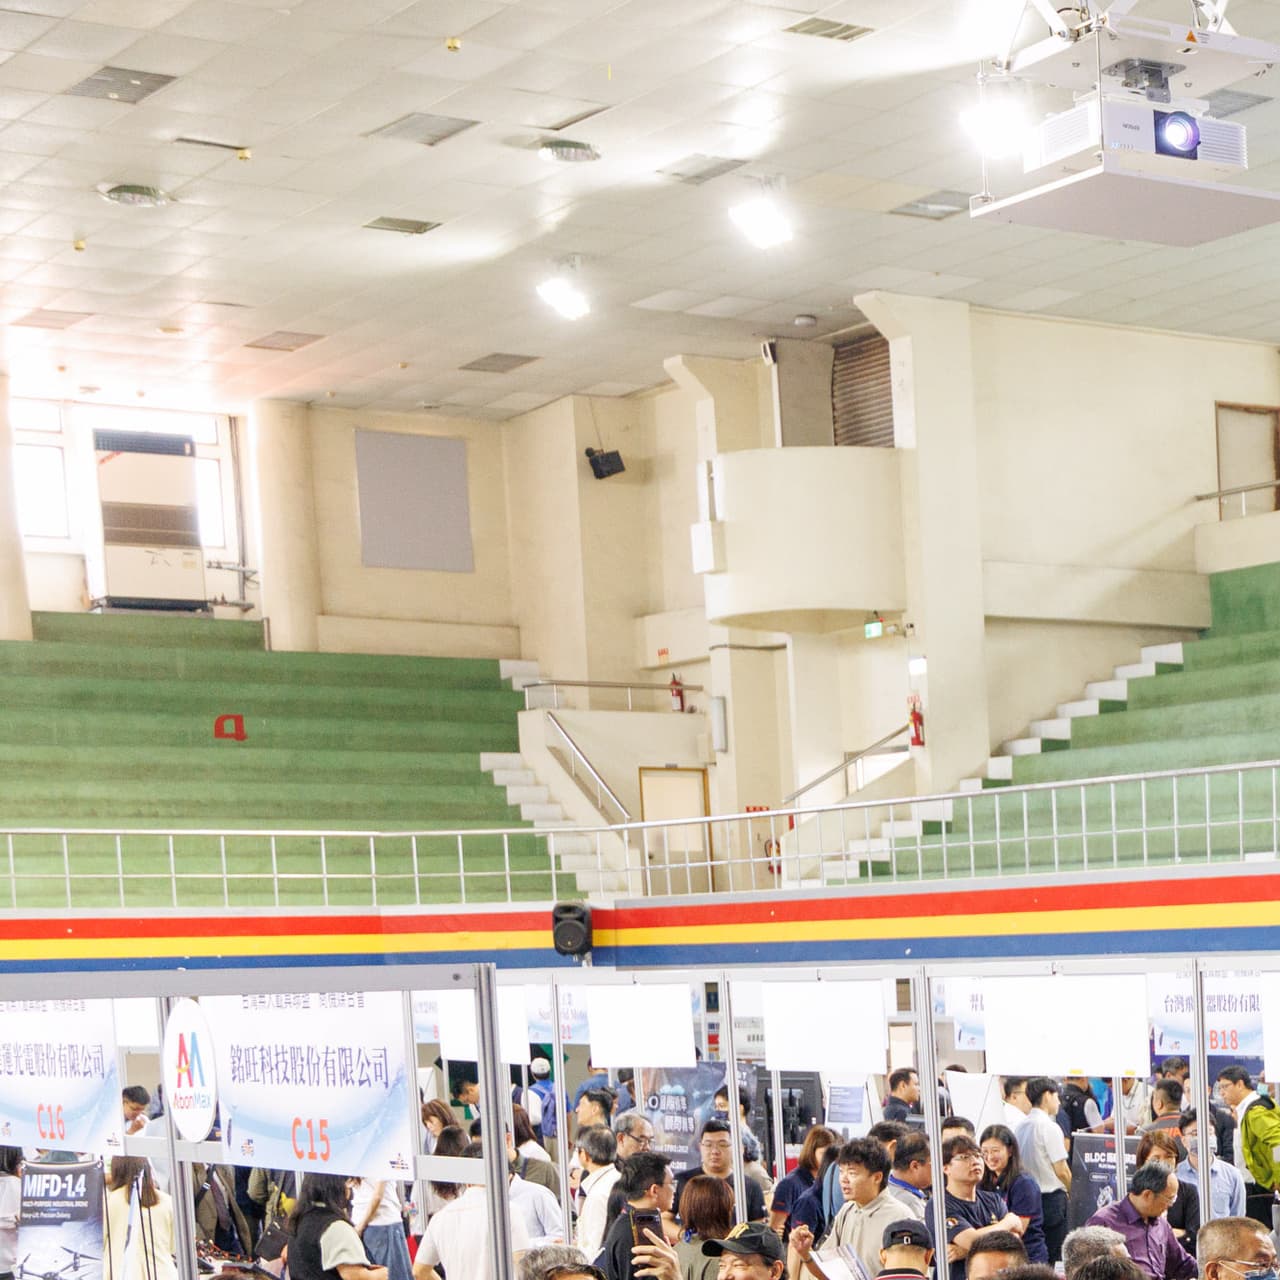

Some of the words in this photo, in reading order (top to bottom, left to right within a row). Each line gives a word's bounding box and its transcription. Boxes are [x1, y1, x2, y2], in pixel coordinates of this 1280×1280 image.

[1209, 1029, 1239, 1050] B18
[0, 1042, 105, 1079] 運光電股份有限公司
[230, 1043, 390, 1090] 銘旺科技股份有限公司
[37, 1103, 65, 1140] C16
[291, 1116, 332, 1163] C15
[23, 1173, 87, 1198] MIFD-1.4
